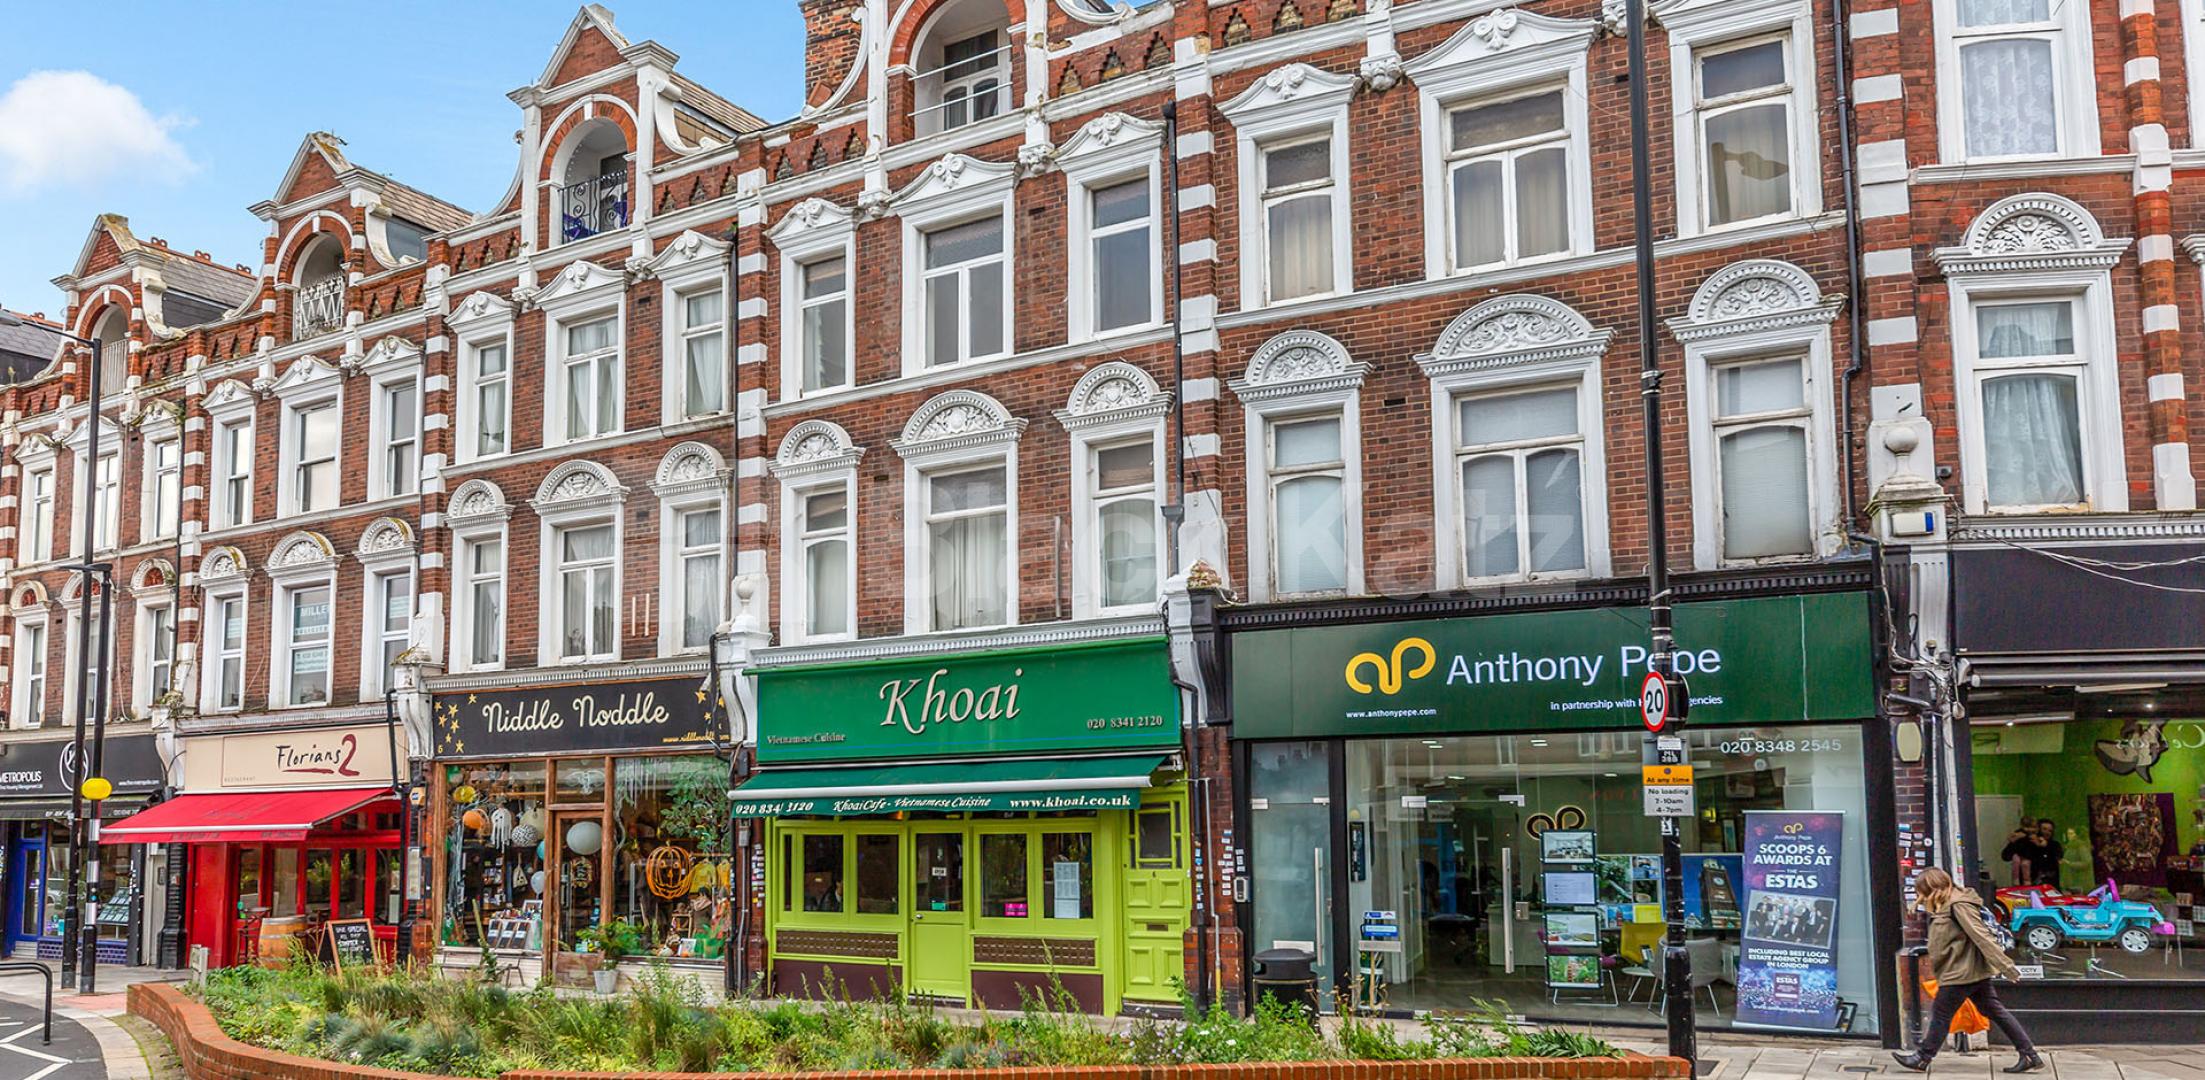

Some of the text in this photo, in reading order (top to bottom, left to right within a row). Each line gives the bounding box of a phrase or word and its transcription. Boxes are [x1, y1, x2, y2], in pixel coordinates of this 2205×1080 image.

[1447, 652, 1603, 687] Anthony
[878, 668, 1024, 735] Khoai
[1550, 702, 1560, 711] in
[1562, 699, 1614, 712] partnership
[1615, 699, 1636, 708] with
[1689, 695, 1722, 707] gencies
[1646, 689, 1663, 714] 20
[482, 691, 669, 733] Niddle Noddle
[1346, 708, 1437, 718] www.anthonypepe.com
[1087, 715, 1163, 730] 020 8341 2120
[767, 732, 846, 744] Vietnamese Cuisine
[1720, 739, 1842, 754] 020 8348 2545
[275, 733, 360, 777] Florians 2
[735, 804, 756, 814] 020
[833, 798, 863, 812] Khoai
[894, 797, 951, 809] Vietnamese
[951, 796, 991, 808] Cuisine
[1010, 795, 1131, 808] www.khoai.co.uk
[1760, 844, 1826, 854] SCOOPS 6
[1753, 855, 1832, 865] AWARDS AT
[1765, 874, 1818, 888] ESTAS
[1748, 948, 1788, 956] INCLUDING
